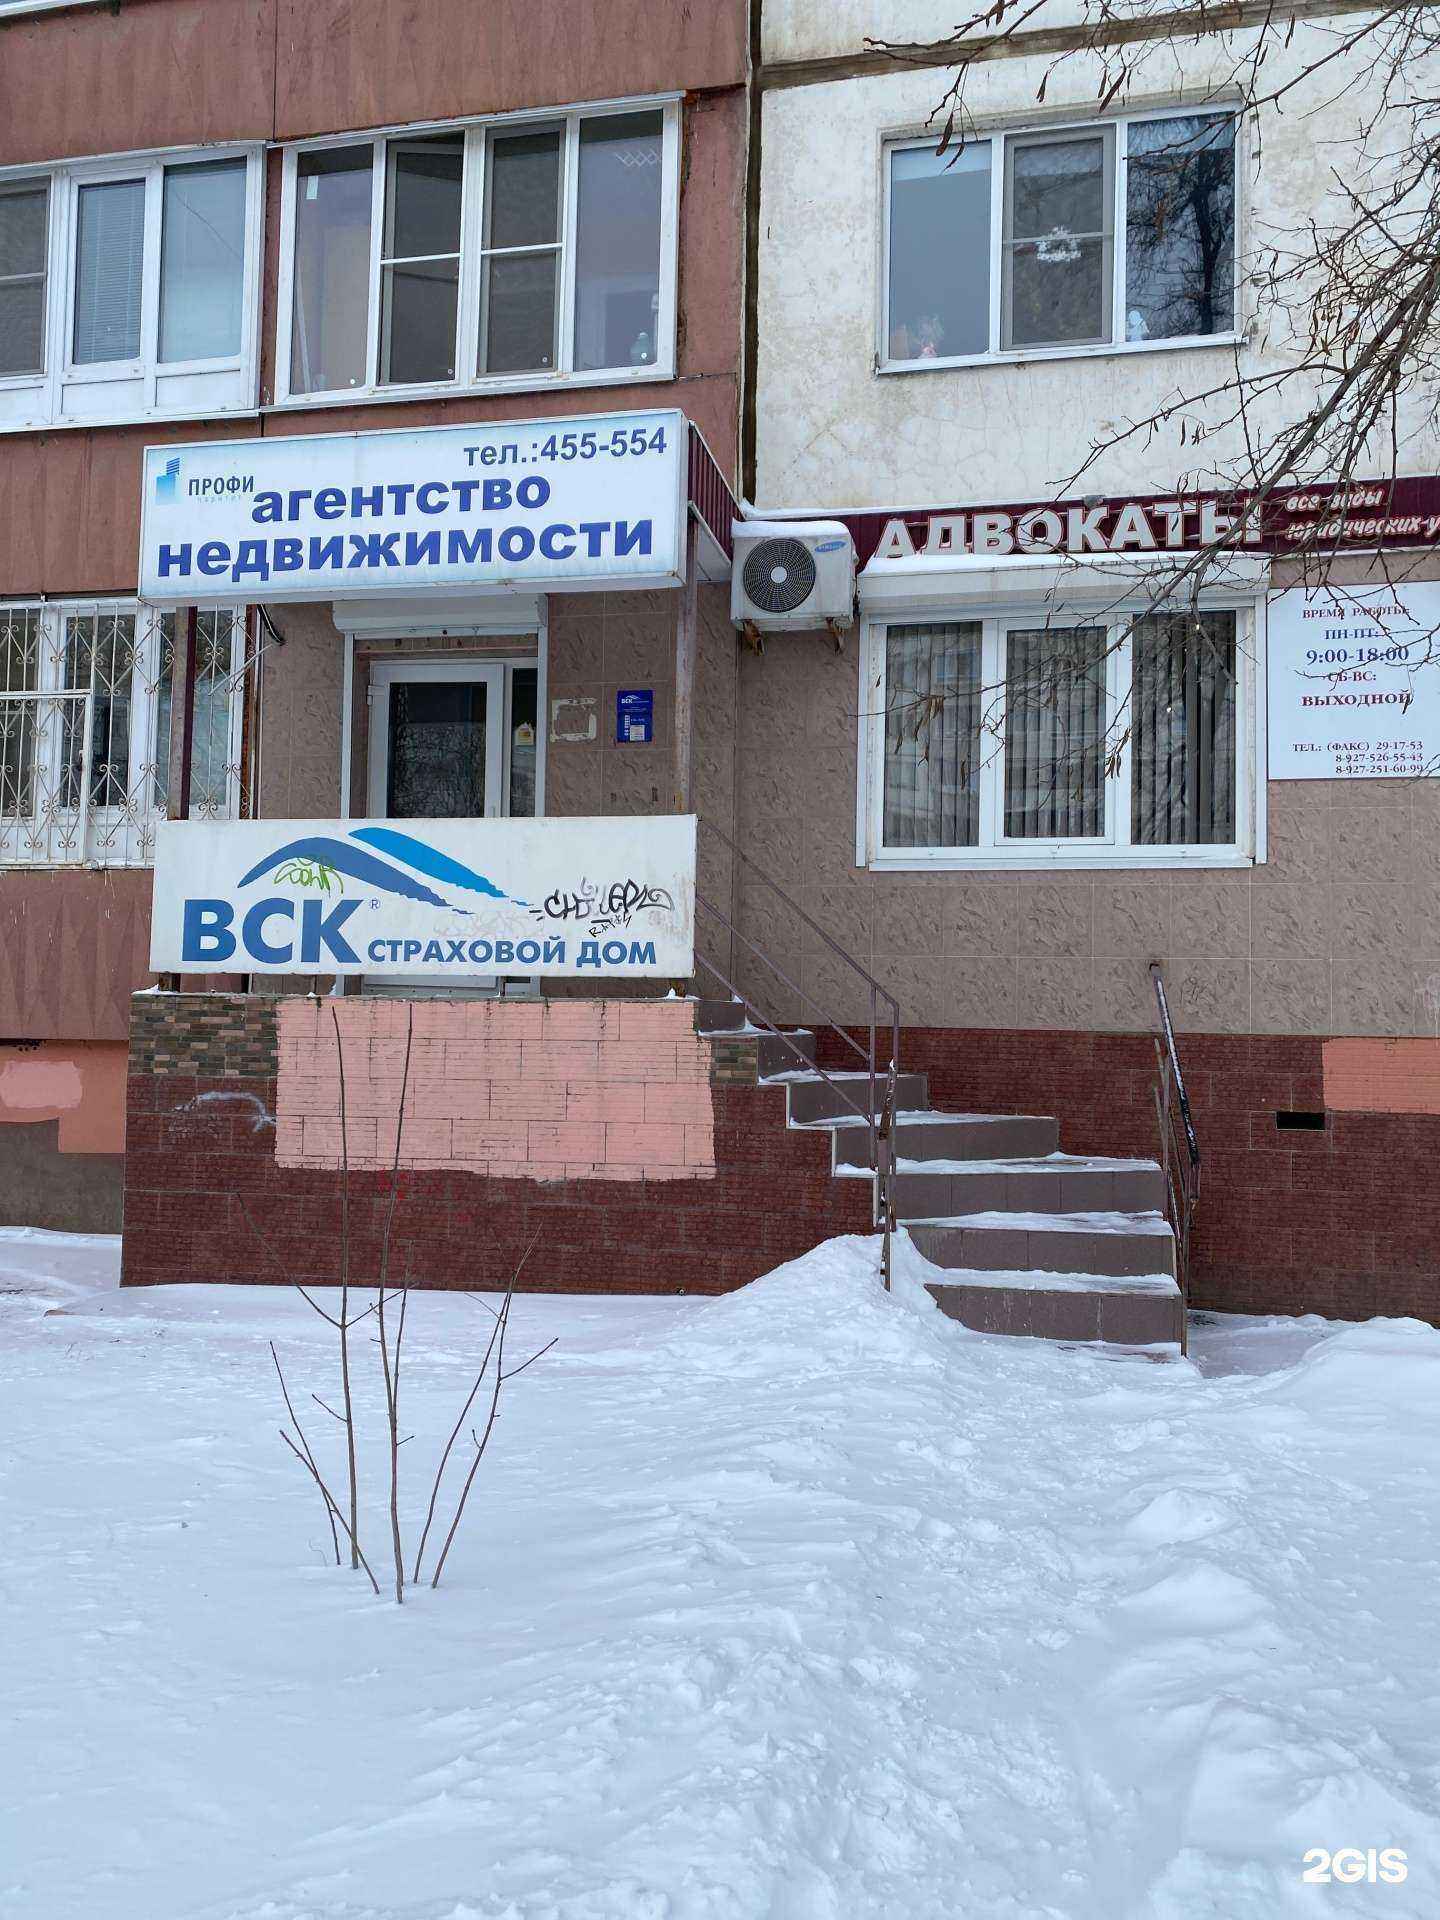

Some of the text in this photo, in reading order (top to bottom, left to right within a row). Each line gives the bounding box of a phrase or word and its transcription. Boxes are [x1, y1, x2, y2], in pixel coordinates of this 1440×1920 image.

[188, 475, 254, 496] ПРОФИ
[252, 474, 551, 524] агентство
[873, 496, 1263, 559] АДВОКАТЫ
[157, 520, 653, 583] недвижимости
[1303, 608, 1344, 619] ВРЕМЯ
[1306, 647, 1409, 666] 9:00-18:00
[1328, 671, 1377, 682] СБ-ВС:
[1302, 691, 1411, 708] ВЫХОДНОЙ
[1327, 741, 1370, 751] (ФАКС)
[1376, 740, 1423, 751] 29-17-53
[183, 898, 657, 968] ВСК СТРАХОВОЙ ДОМ
